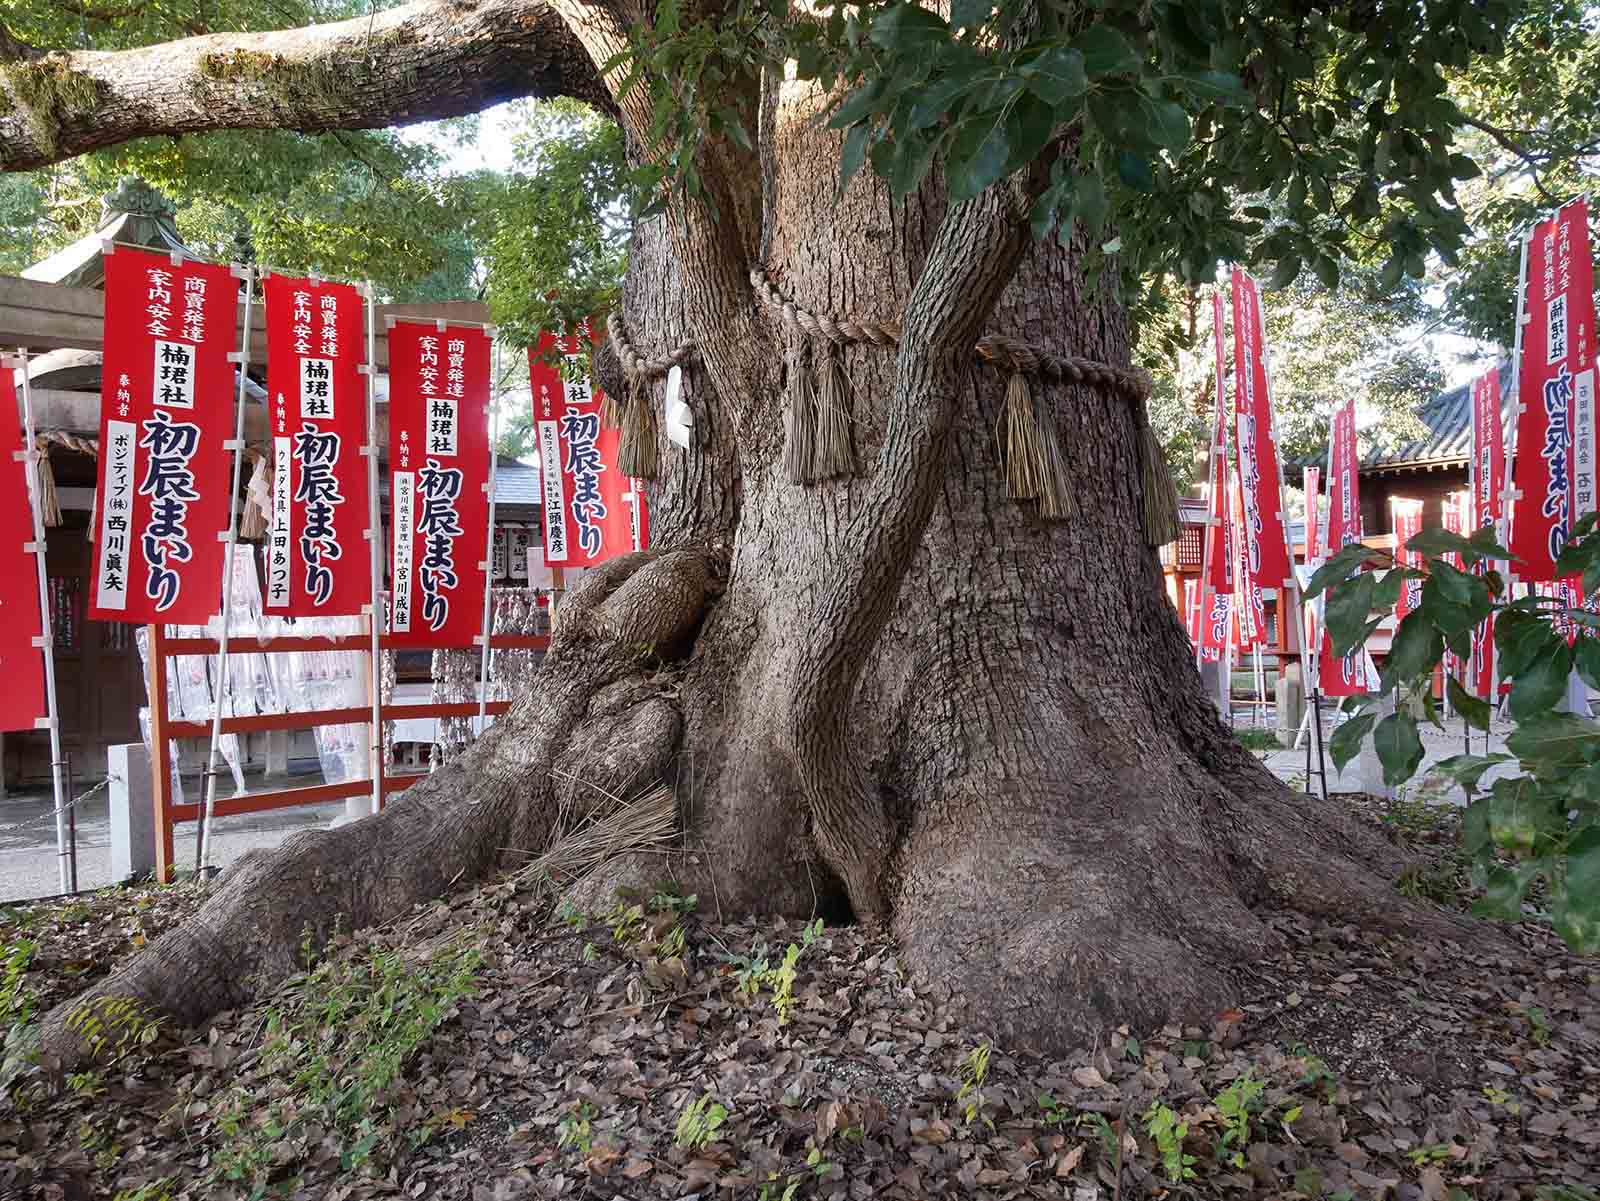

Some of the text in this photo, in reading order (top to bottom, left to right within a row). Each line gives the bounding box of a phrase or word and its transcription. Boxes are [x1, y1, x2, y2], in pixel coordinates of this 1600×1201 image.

[145, 269, 174, 337] 家内安全
[293, 290, 313, 354] 家内安全
[160, 343, 190, 404] 楠珺社
[305, 360, 330, 416] 楠珺社
[418, 335, 439, 395] 家内安全
[432, 400, 454, 453] 楠珺社
[139, 410, 201, 612] 初辰まいり
[293, 422, 344, 606] 初辰まいり
[560, 407, 607, 560] 初辰まいり
[270, 517, 288, 599] 上田あつ子
[417, 458, 463, 632] 初辰まいり
